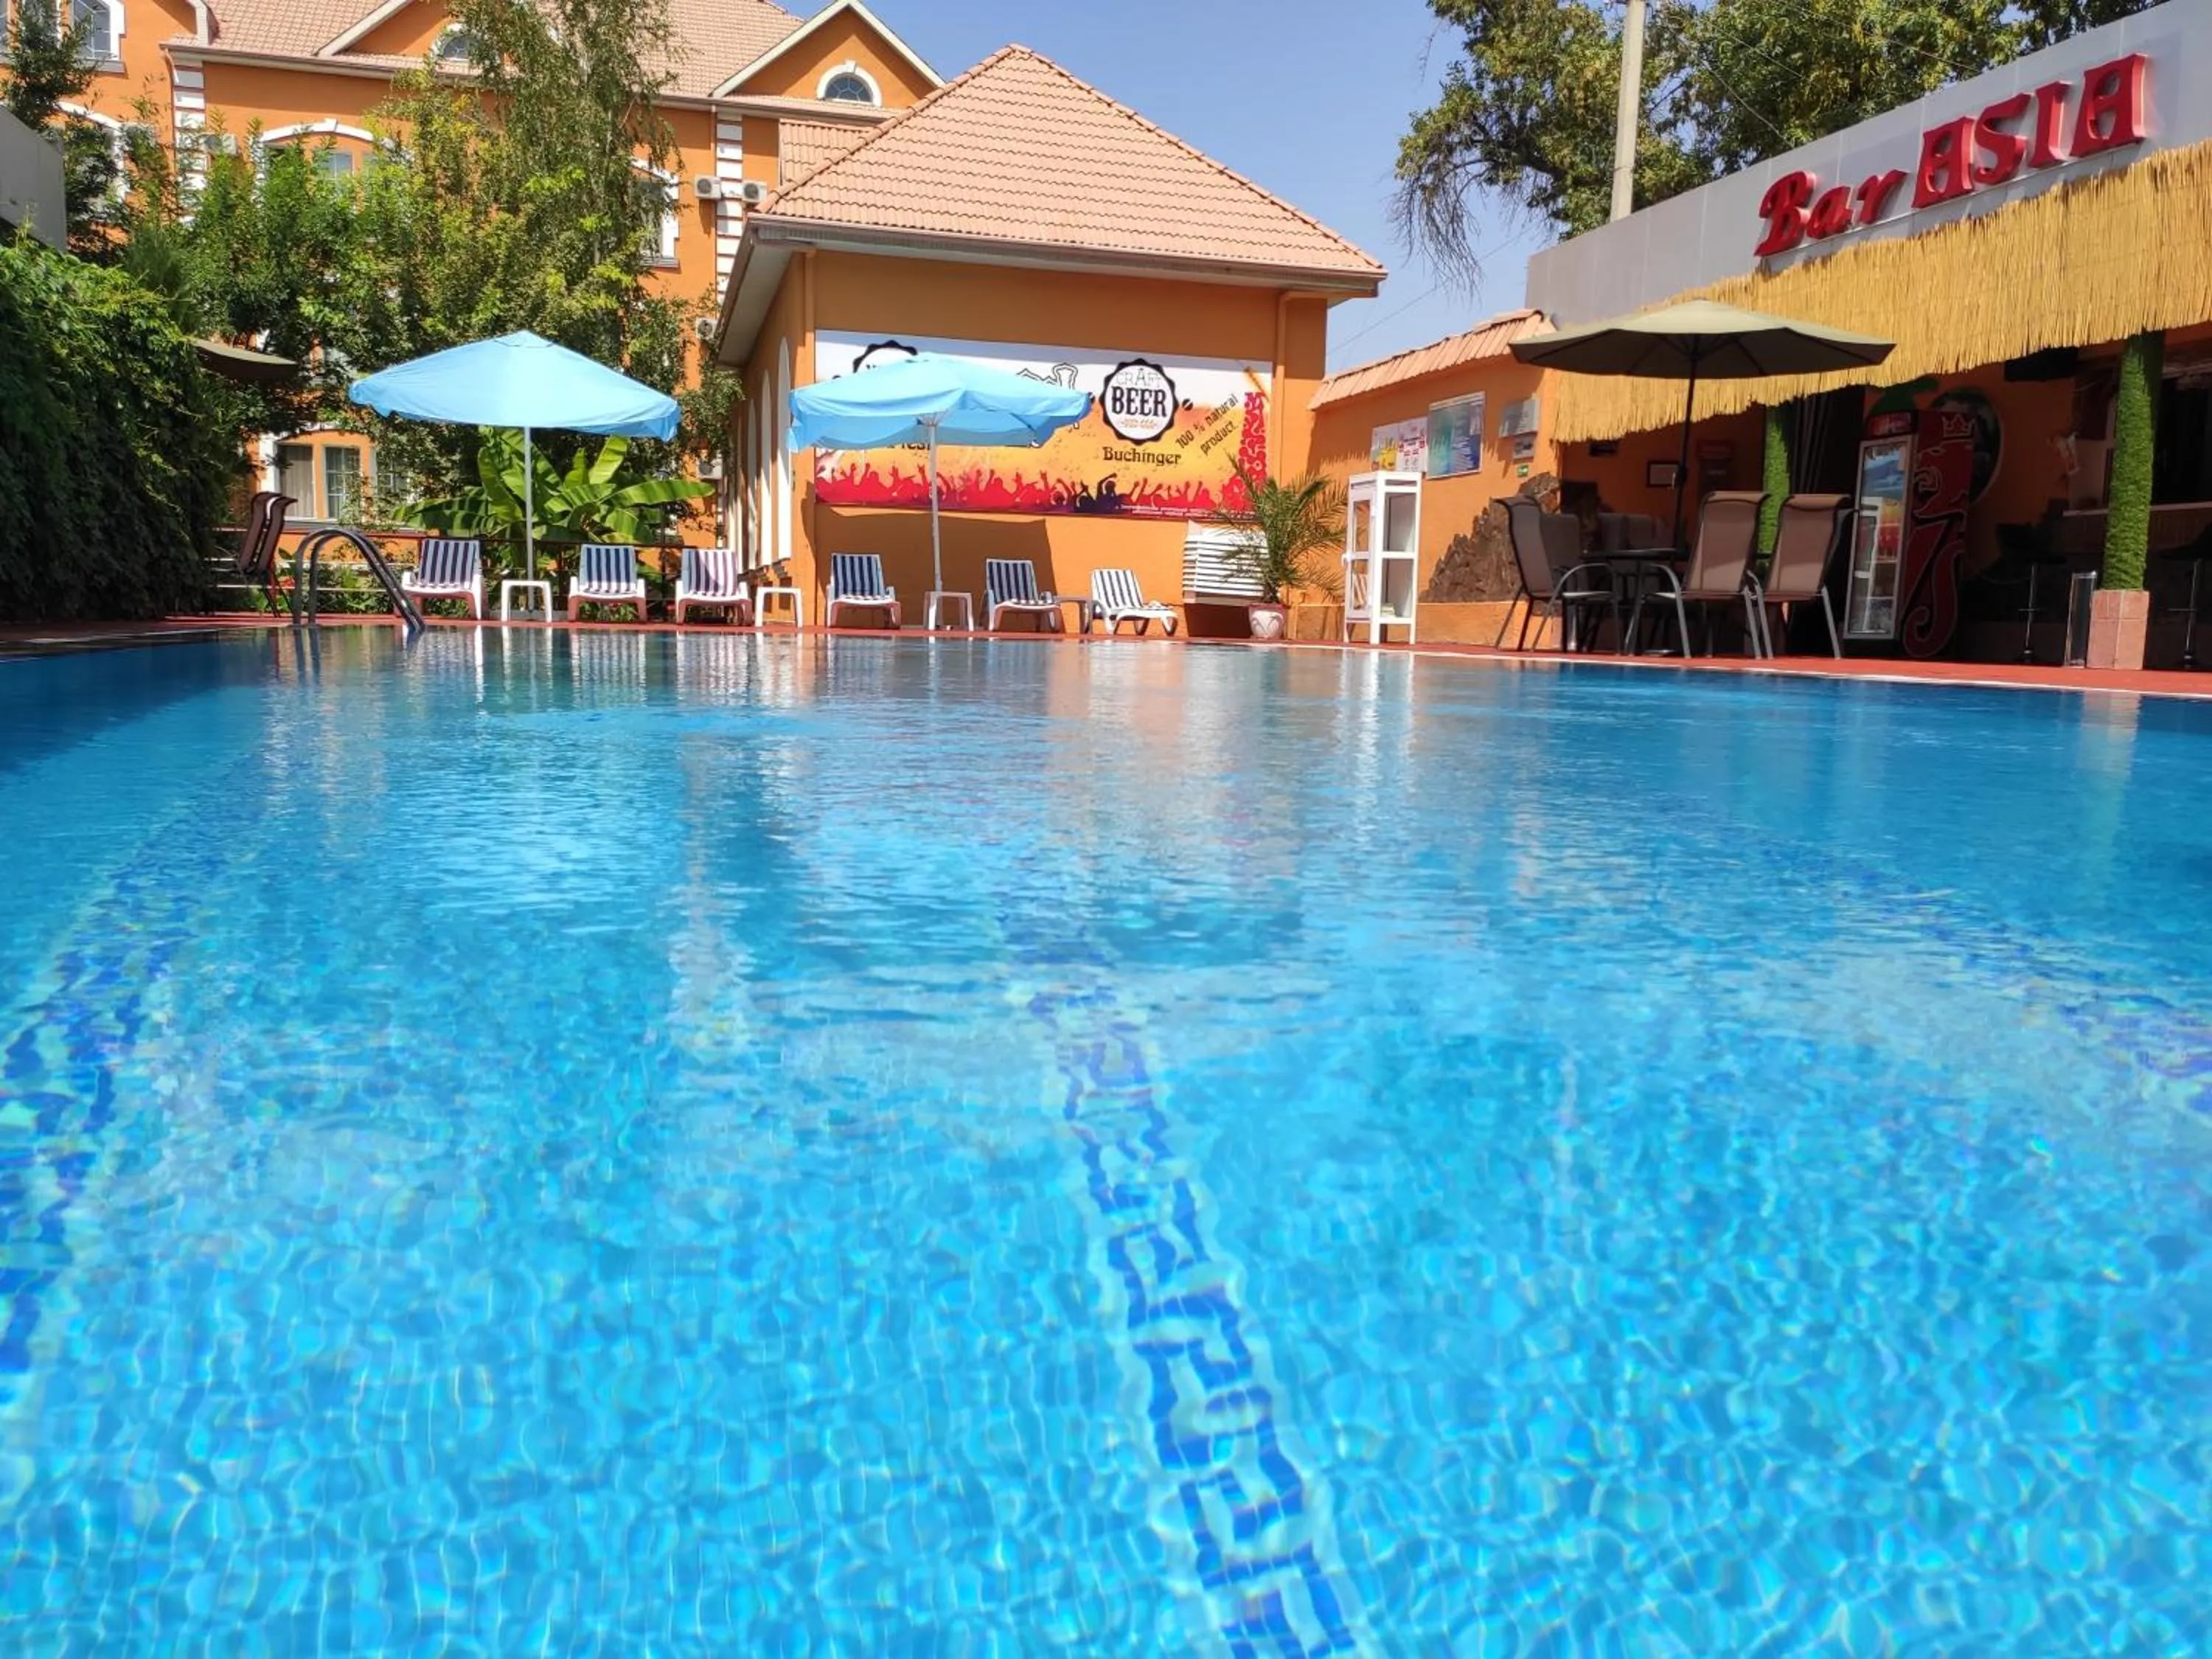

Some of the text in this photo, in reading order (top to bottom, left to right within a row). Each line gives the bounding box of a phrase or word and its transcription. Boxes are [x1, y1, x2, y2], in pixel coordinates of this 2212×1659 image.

[1754, 53, 2147, 256] Bar ASIA
[1116, 368, 1161, 387] CRAFT
[1112, 386, 1167, 417] BEER
[1175, 430, 1194, 449] 100
[1205, 393, 1239, 427] natural
[1200, 420, 1237, 456] product
[1102, 447, 1182, 466] Buchinger
